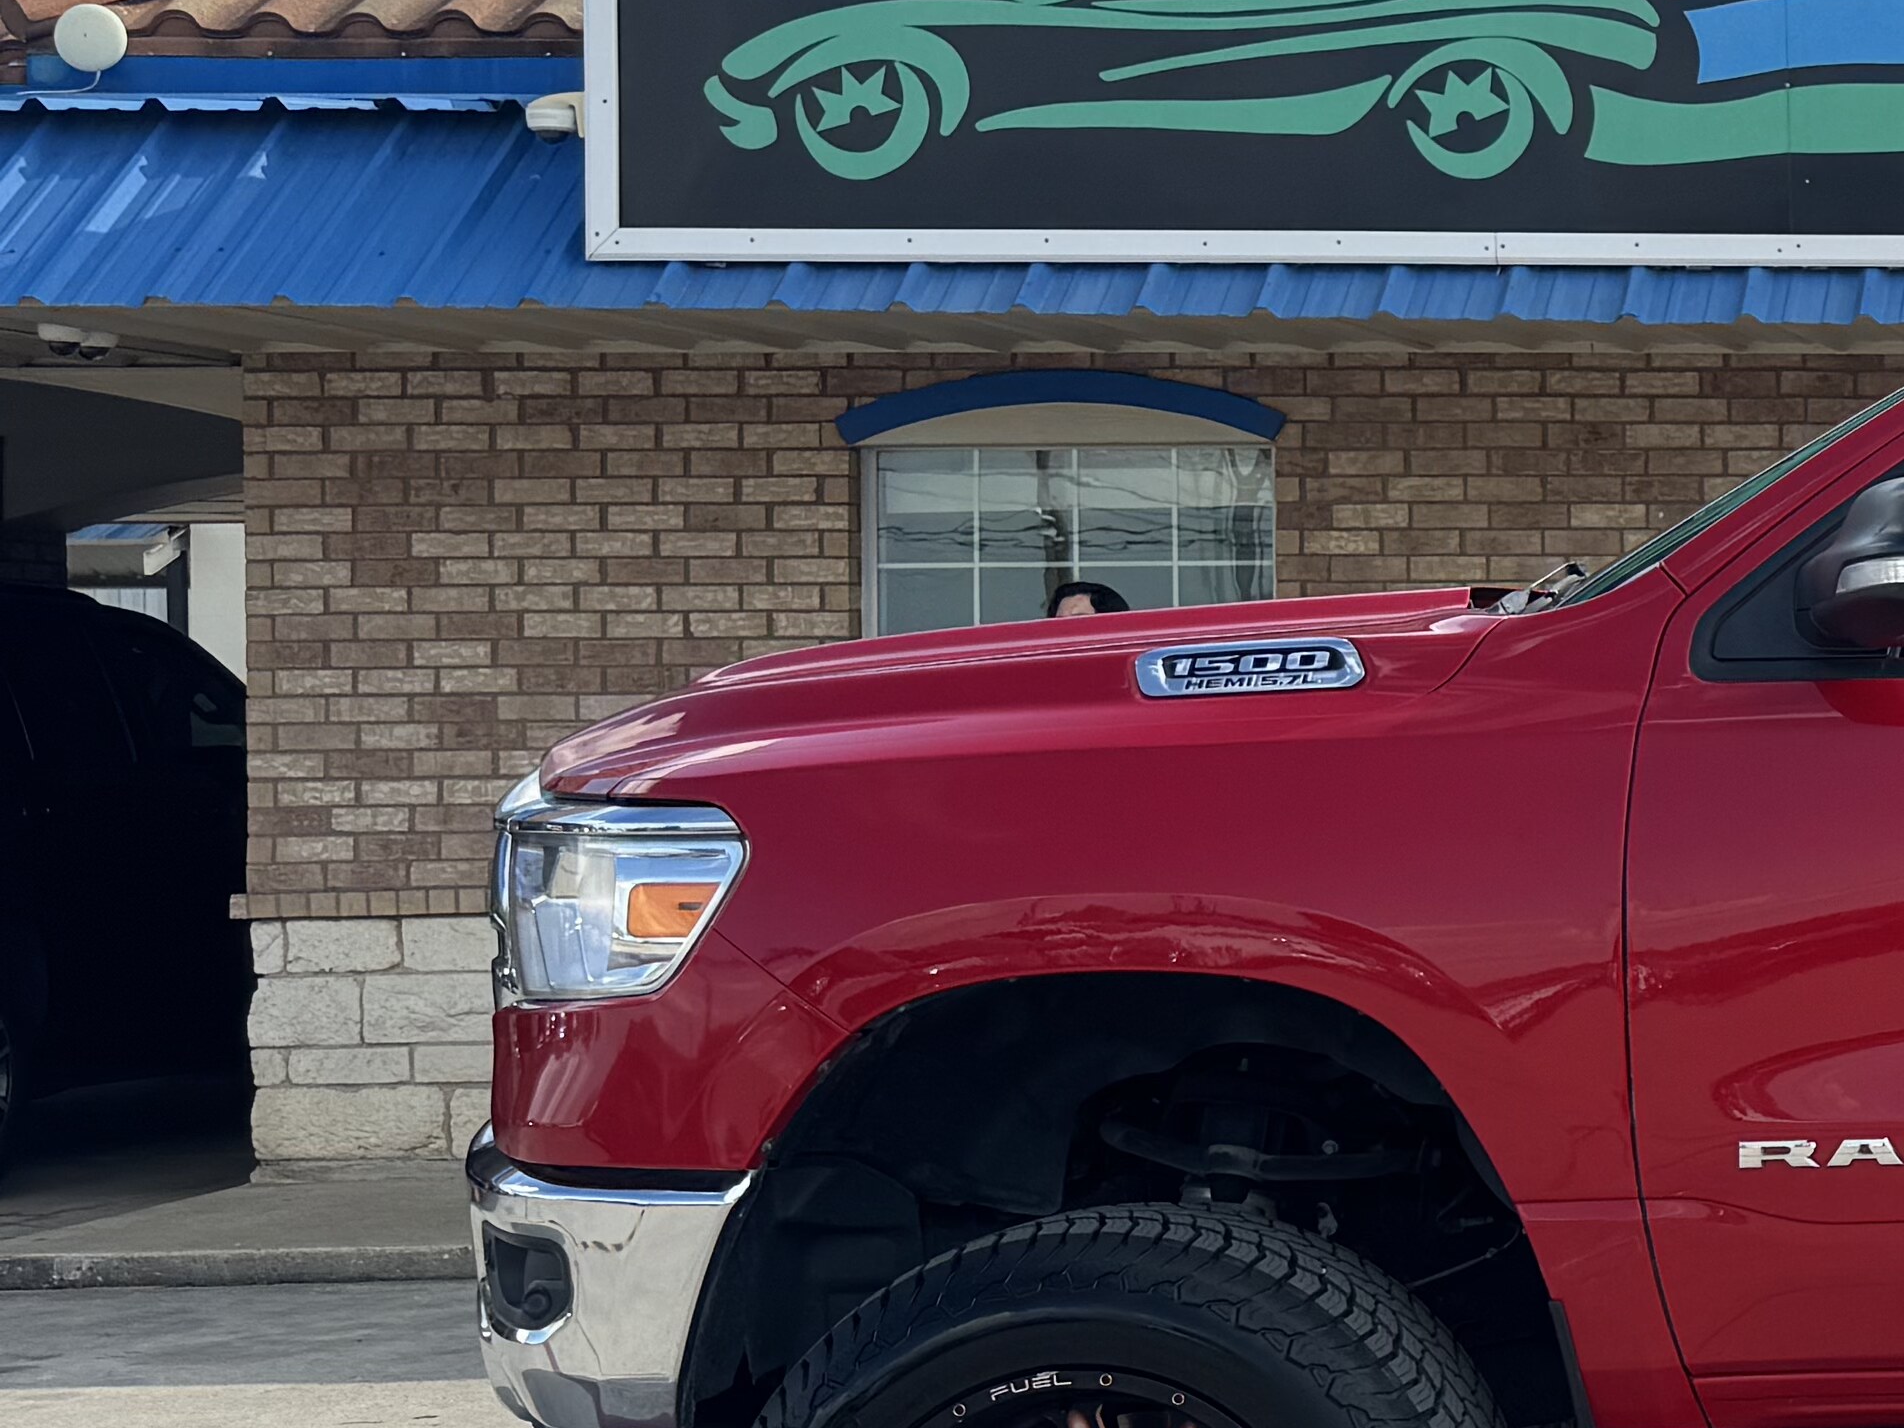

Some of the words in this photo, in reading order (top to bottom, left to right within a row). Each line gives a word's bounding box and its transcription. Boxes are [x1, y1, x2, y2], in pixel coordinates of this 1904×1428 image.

[1170, 650, 1331, 676] 1500
[1184, 675, 1252, 690] HEMI
[1259, 672, 1322, 688] 5.7L
[988, 1373, 1073, 1402] FUEL
